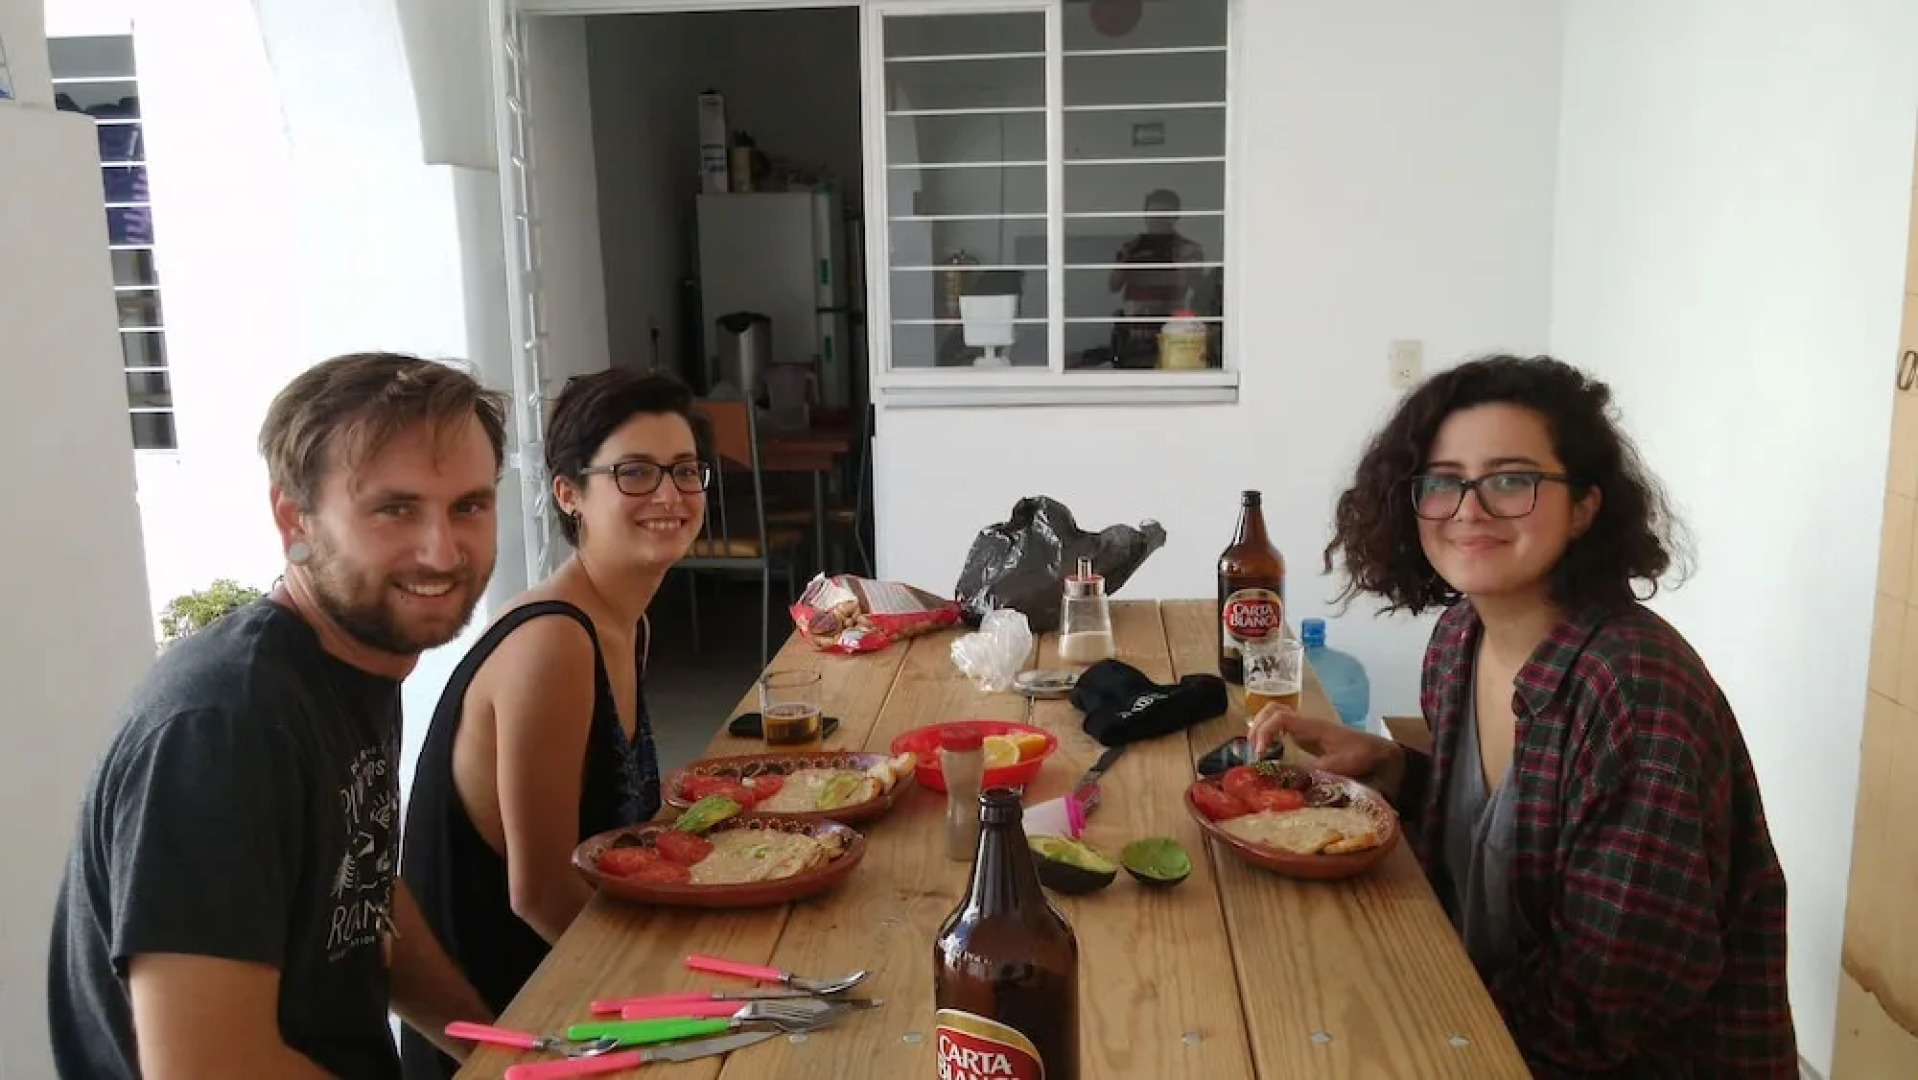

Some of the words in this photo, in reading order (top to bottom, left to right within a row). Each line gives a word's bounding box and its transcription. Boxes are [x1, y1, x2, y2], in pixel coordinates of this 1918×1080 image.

[1232, 603, 1274, 616] CARTA
[1229, 613, 1279, 628] BLANCA
[938, 1035, 1014, 1076] CARTA
